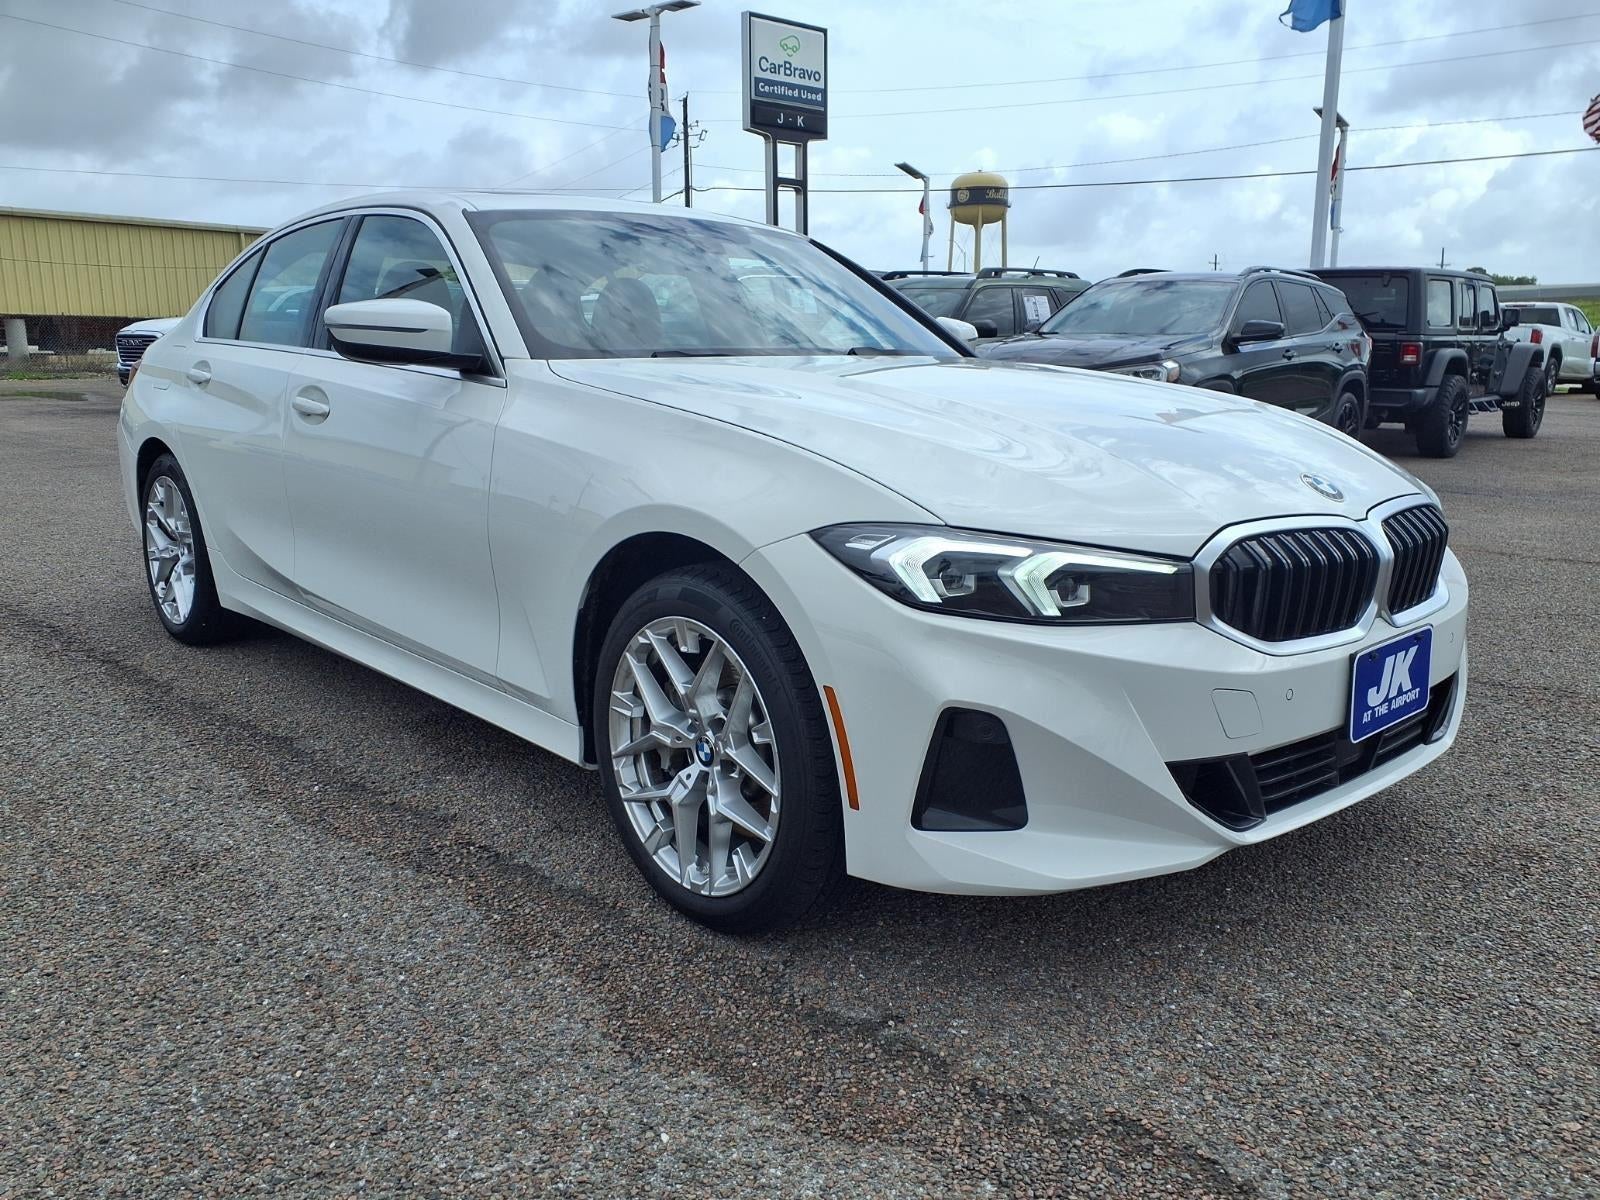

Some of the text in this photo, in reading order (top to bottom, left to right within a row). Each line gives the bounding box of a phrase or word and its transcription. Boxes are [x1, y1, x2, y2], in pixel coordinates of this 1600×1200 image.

[758, 56, 822, 82] CarBravo
[758, 82, 822, 101] Certified Used
[1367, 644, 1419, 707] JK
[1363, 688, 1420, 724] AT THE AIRPORT
